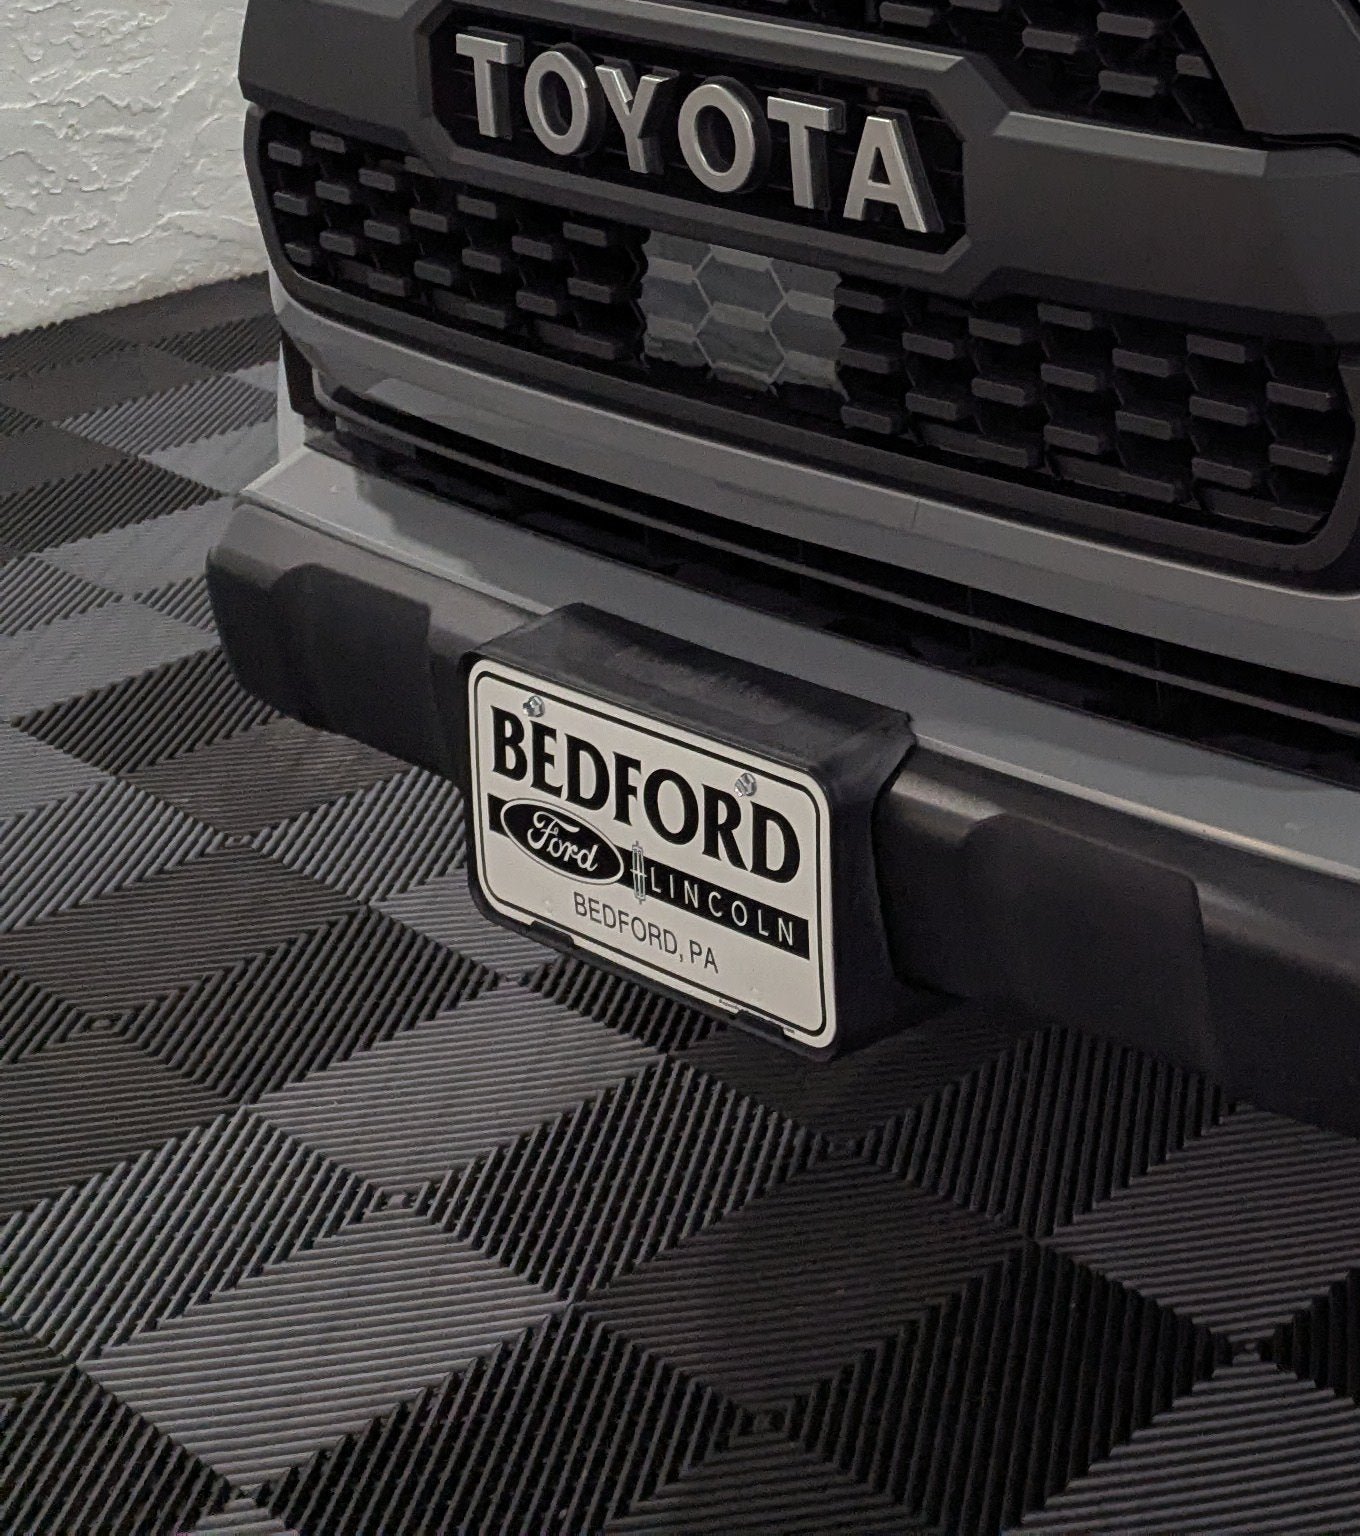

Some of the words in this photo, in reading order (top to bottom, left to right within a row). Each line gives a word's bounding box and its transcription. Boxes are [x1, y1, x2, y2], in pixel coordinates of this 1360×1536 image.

[455, 31, 947, 234] TOYOTA
[490, 704, 801, 885] BEDFORD
[526, 810, 600, 873] Ford
[573, 891, 684, 964] BEDFORD,
[689, 937, 719, 975] PA
[649, 865, 795, 947] LINCOLN
